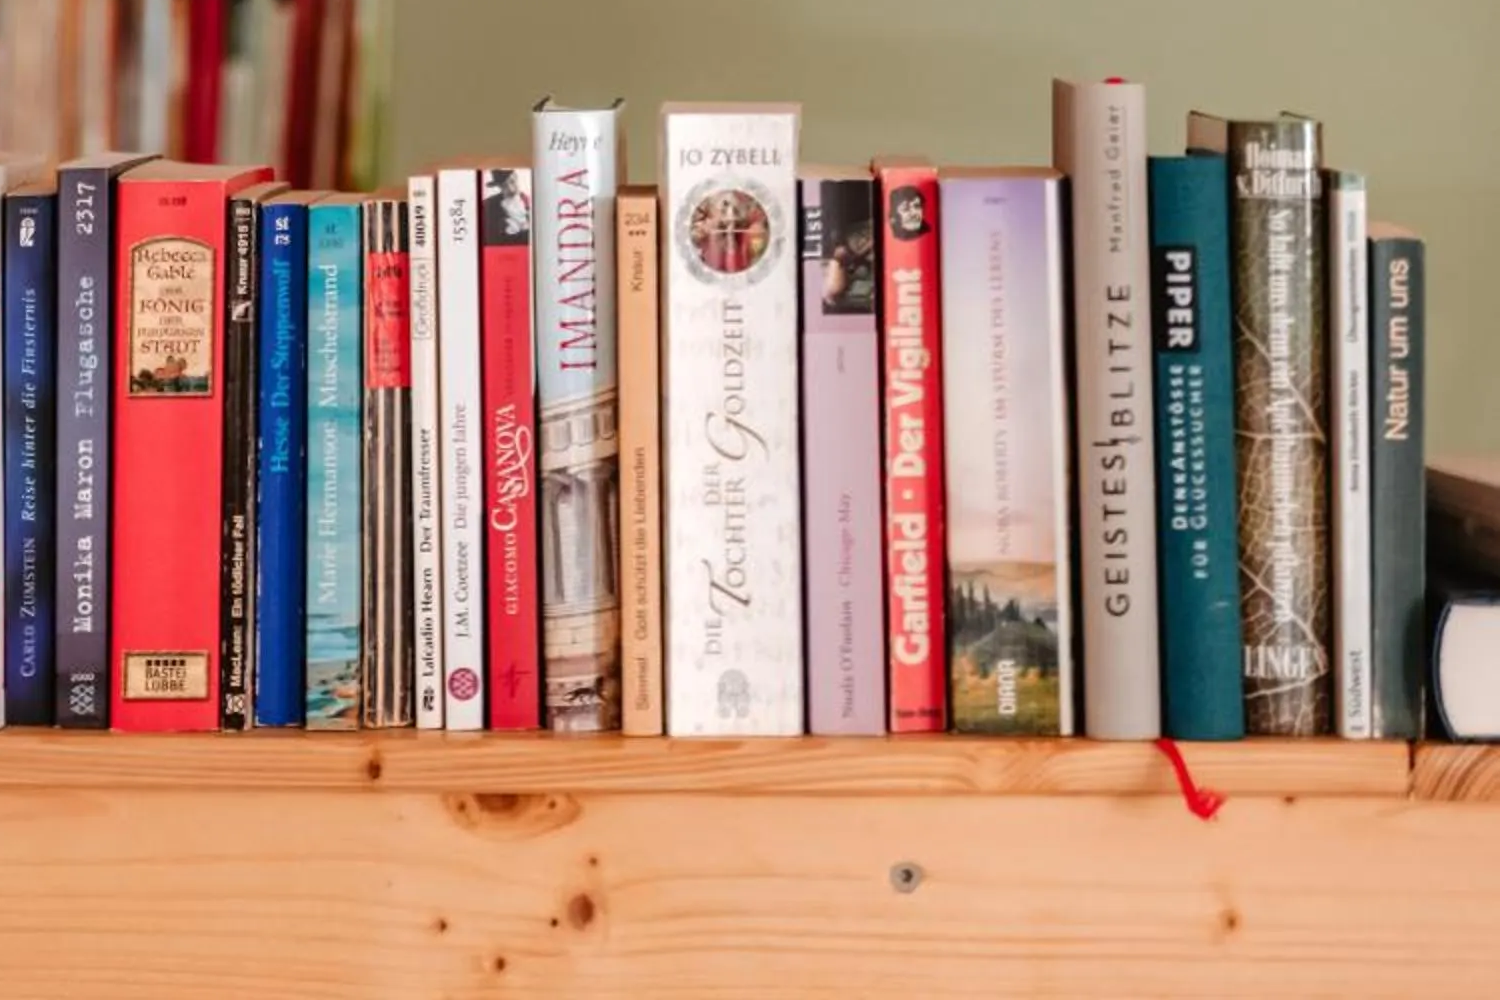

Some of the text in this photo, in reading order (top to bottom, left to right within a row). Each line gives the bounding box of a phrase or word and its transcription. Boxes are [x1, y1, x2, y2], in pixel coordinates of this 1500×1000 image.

[678, 147, 781, 168] JO ZYBELL
[1105, 104, 1123, 253] Manfred Geier
[76, 181, 97, 235] 2317
[450, 198, 468, 242] 15584
[802, 207, 823, 259] List
[556, 168, 598, 370] IMANDRA
[1165, 251, 1194, 348] PIPER
[270, 258, 296, 472] Hesse Der Steppenwolf
[889, 268, 931, 408] Vigilant
[1384, 257, 1410, 440] Natur um uns
[452, 402, 468, 442] Jahre
[703, 299, 770, 506] DER GOLDZEIT
[20, 288, 37, 678] CARLO ZUMSTEIN Reise hinter die Finsternis
[73, 276, 98, 633] Monika Maron Flugasche
[417, 428, 433, 521] Traumfresser
[453, 447, 470, 500] jungen
[491, 404, 529, 532] CASANOVA
[891, 412, 926, 478] Der
[419, 526, 433, 553] Der
[454, 502, 468, 530] Die
[420, 567, 435, 612] Hearn
[454, 540, 470, 603] Coetzee
[701, 477, 751, 656] DIE TOCHTER
[892, 512, 931, 666] Garfield
[145, 667, 187, 679] BASTEI
[420, 615, 435, 677] Lafcadio
